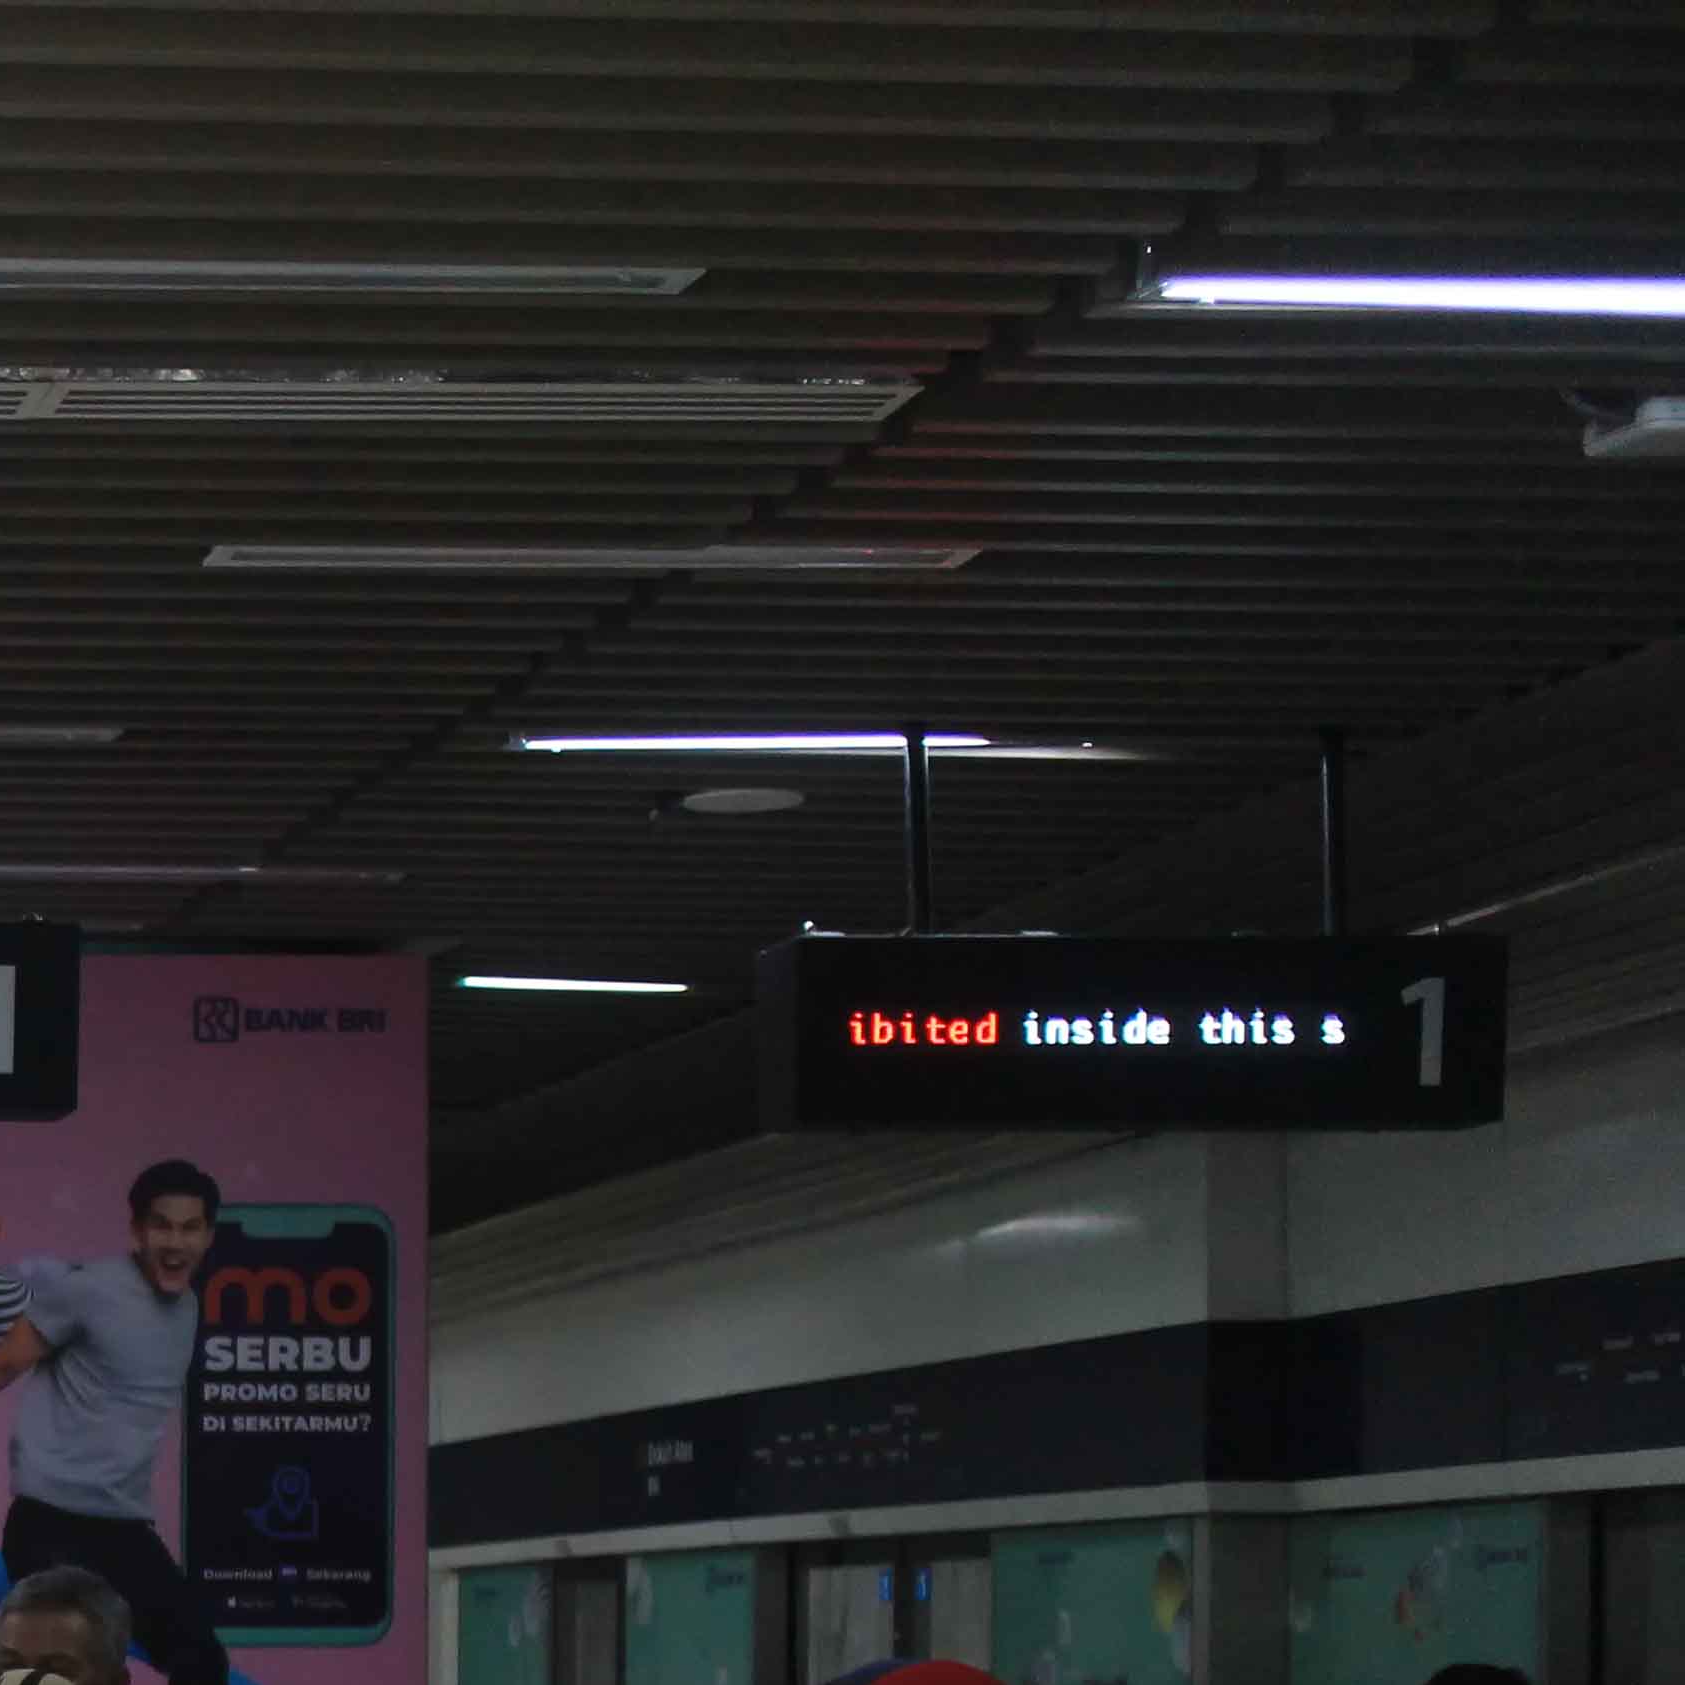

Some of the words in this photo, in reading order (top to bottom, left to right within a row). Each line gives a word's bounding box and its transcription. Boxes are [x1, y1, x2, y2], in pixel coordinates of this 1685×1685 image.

[244, 1007, 329, 1032] BANK
[336, 1007, 388, 1033] BRI
[848, 1010, 998, 1046] ibited
[1022, 1008, 1172, 1047] inside
[1198, 1007, 1297, 1047] this
[1321, 1013, 1347, 1046] s
[1400, 976, 1446, 1087] 1
[204, 1265, 373, 1326] mo
[203, 1335, 373, 1372] SERBU
[203, 1383, 298, 1402] PROMO
[305, 1383, 372, 1402] SERU
